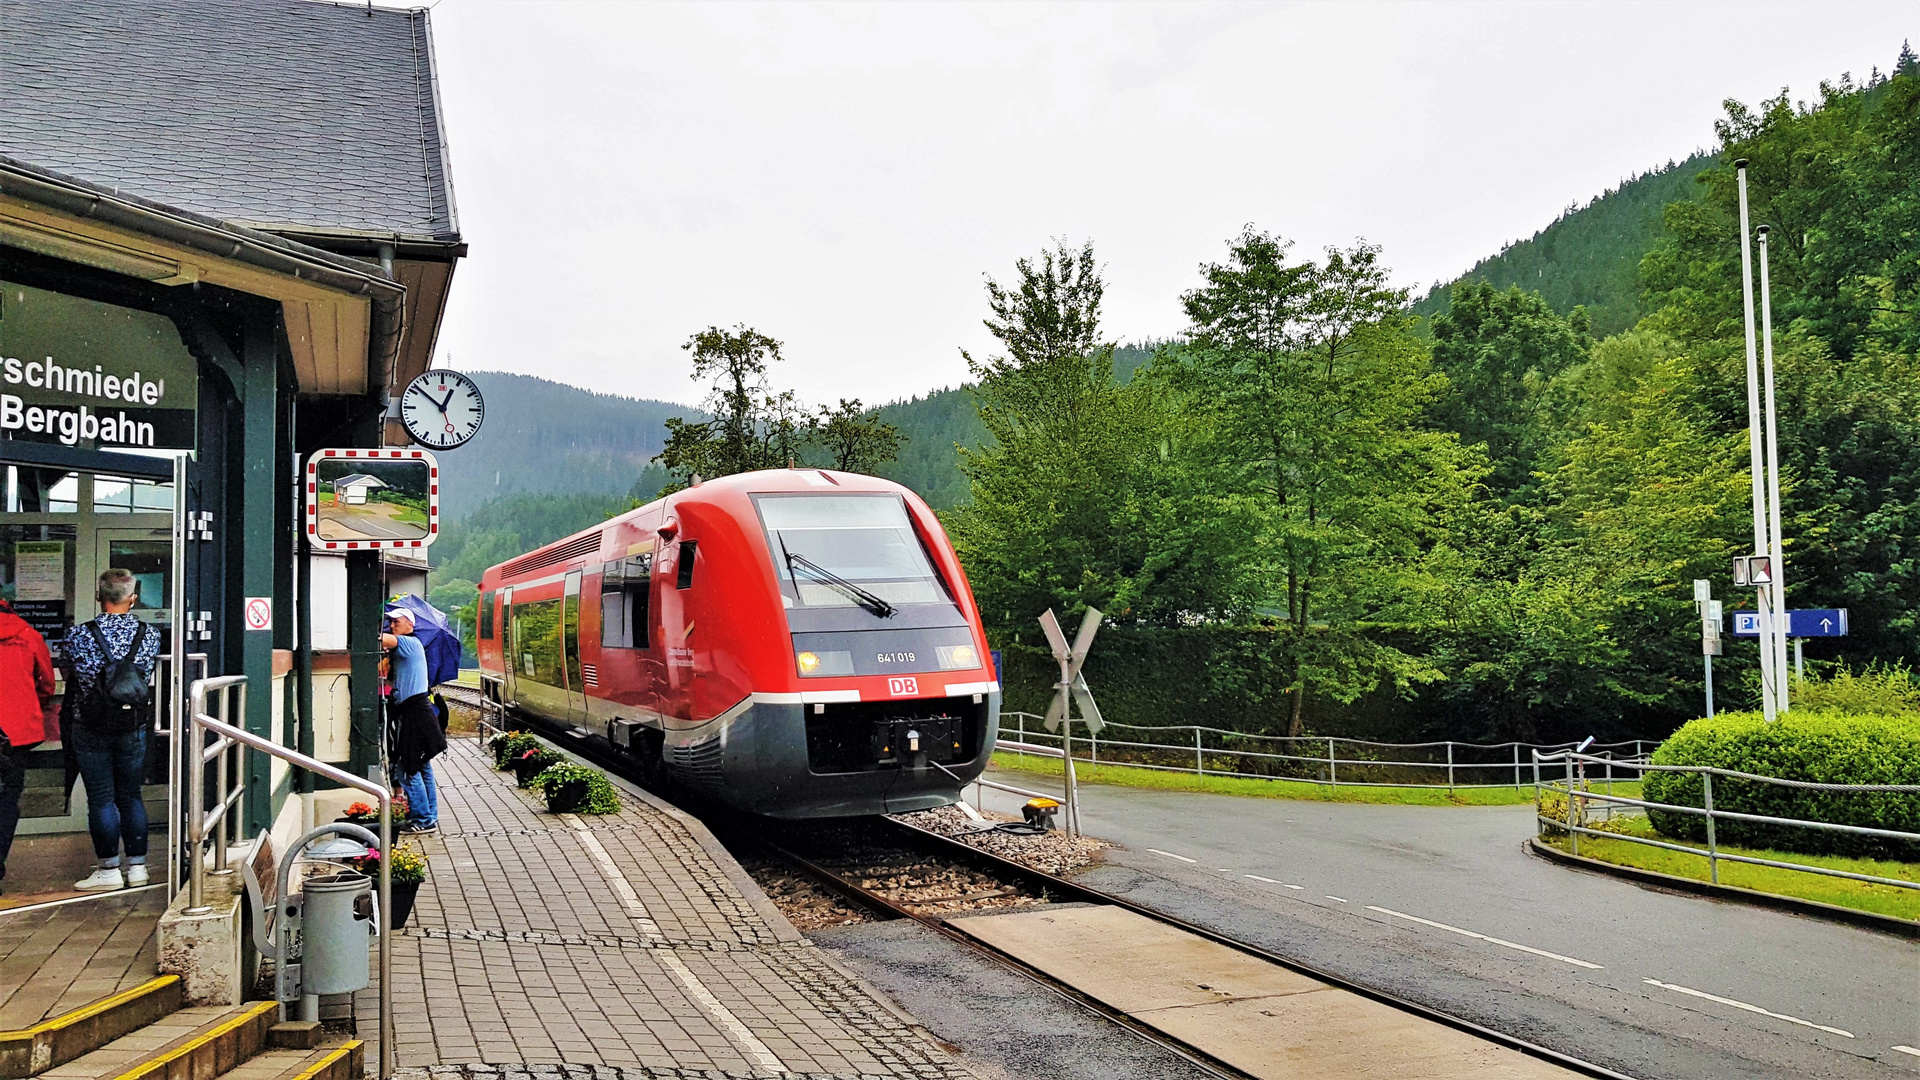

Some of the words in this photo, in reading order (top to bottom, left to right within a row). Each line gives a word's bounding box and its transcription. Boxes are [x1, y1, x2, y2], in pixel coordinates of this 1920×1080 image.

[0, 356, 158, 405] schmiede
[0, 394, 155, 446] Bergbahn
[877, 652, 896, 663] 641
[897, 652, 916, 662] 019
[890, 678, 917, 694] DB
